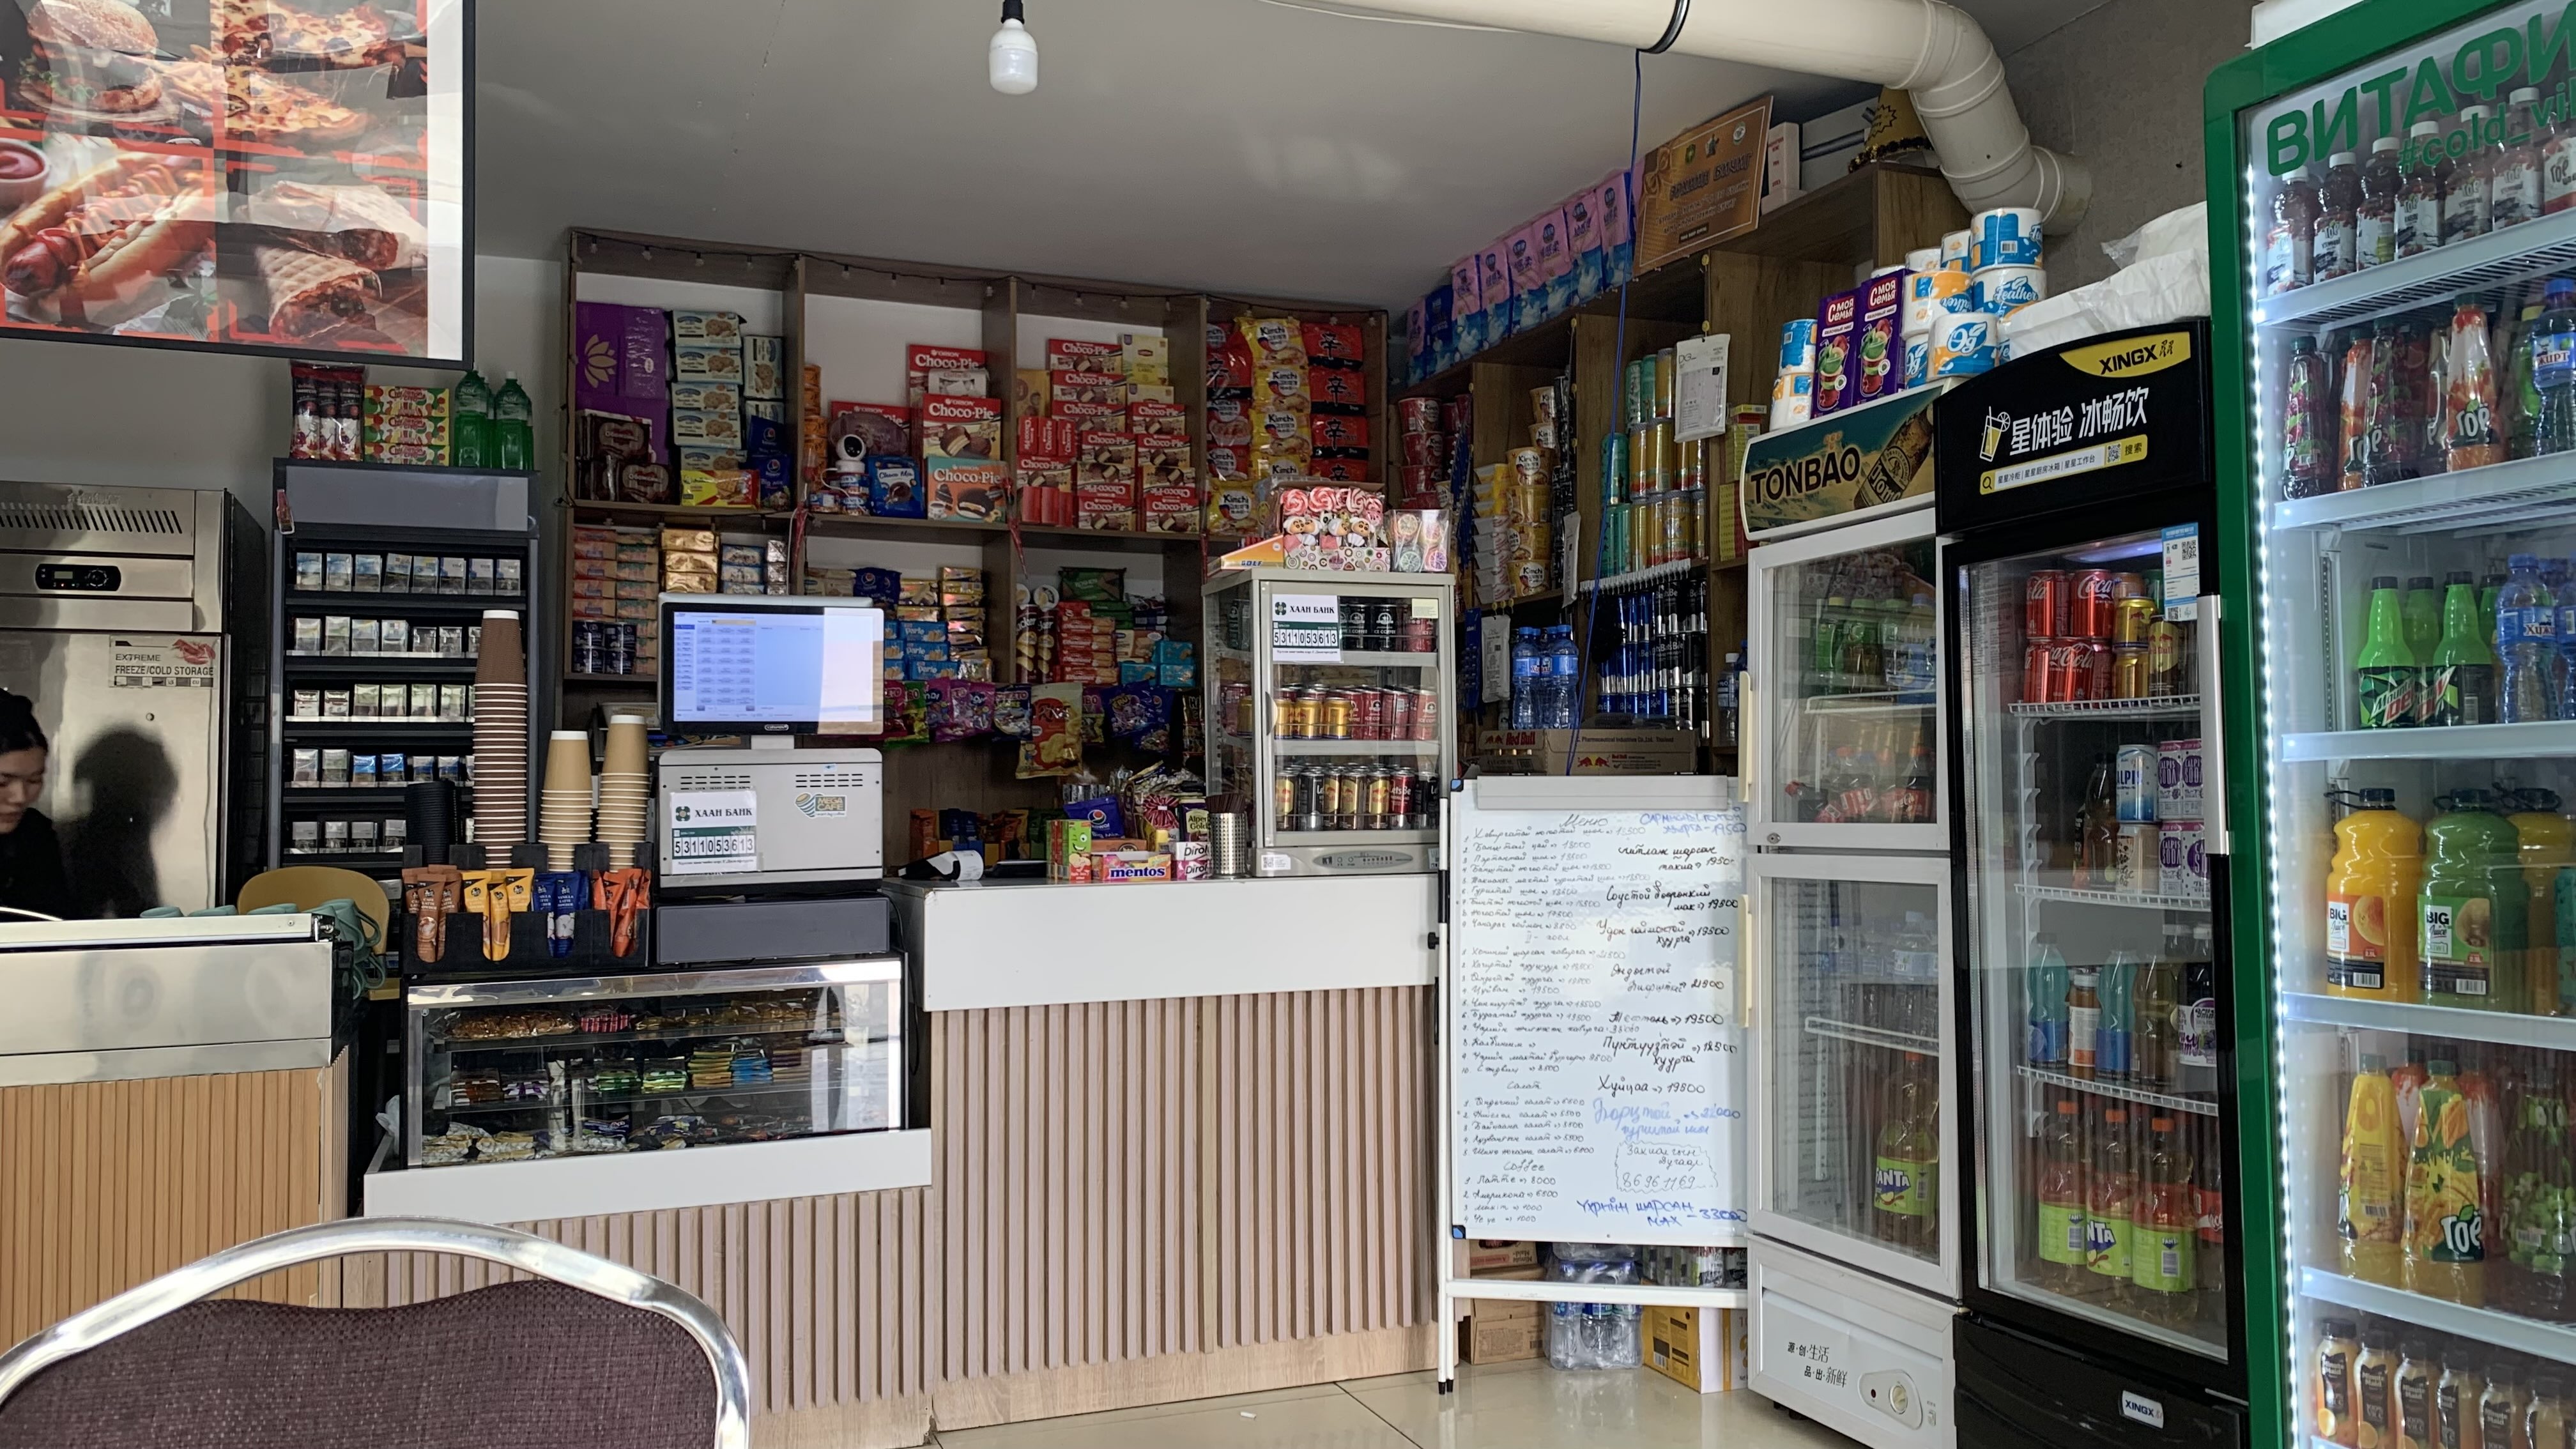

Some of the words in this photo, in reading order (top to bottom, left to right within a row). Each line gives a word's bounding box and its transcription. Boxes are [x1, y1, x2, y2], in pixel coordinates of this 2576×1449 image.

[2099, 344, 2158, 376] XINGX
[928, 402, 995, 420] Choco-Pie
[2010, 406, 2074, 456] 星体验
[2079, 387, 2149, 439] 冰畅饮
[2125, 443, 2142, 456] 搜索
[934, 468, 1001, 484] Choco-Pie
[1751, 446, 1860, 505] TONBAO
[1289, 605, 1312, 614] ХААН
[1313, 606, 1335, 615] БАНК
[1273, 630, 1337, 645] 5311053613
[115, 653, 161, 662] EXTREME
[115, 665, 172, 675] FREEZE/COLD
[174, 666, 214, 677] STORAGE
[694, 808, 723, 818] ХААН
[725, 808, 753, 816] БАНК
[674, 838, 754, 854] 5311053613
[1108, 865, 1165, 879] mentos
[2329, 907, 2348, 921] BIG
[2426, 912, 2450, 925] BIG
[2087, 1221, 2115, 1243] NTA
[2124, 1398, 2154, 1417] XINGX
